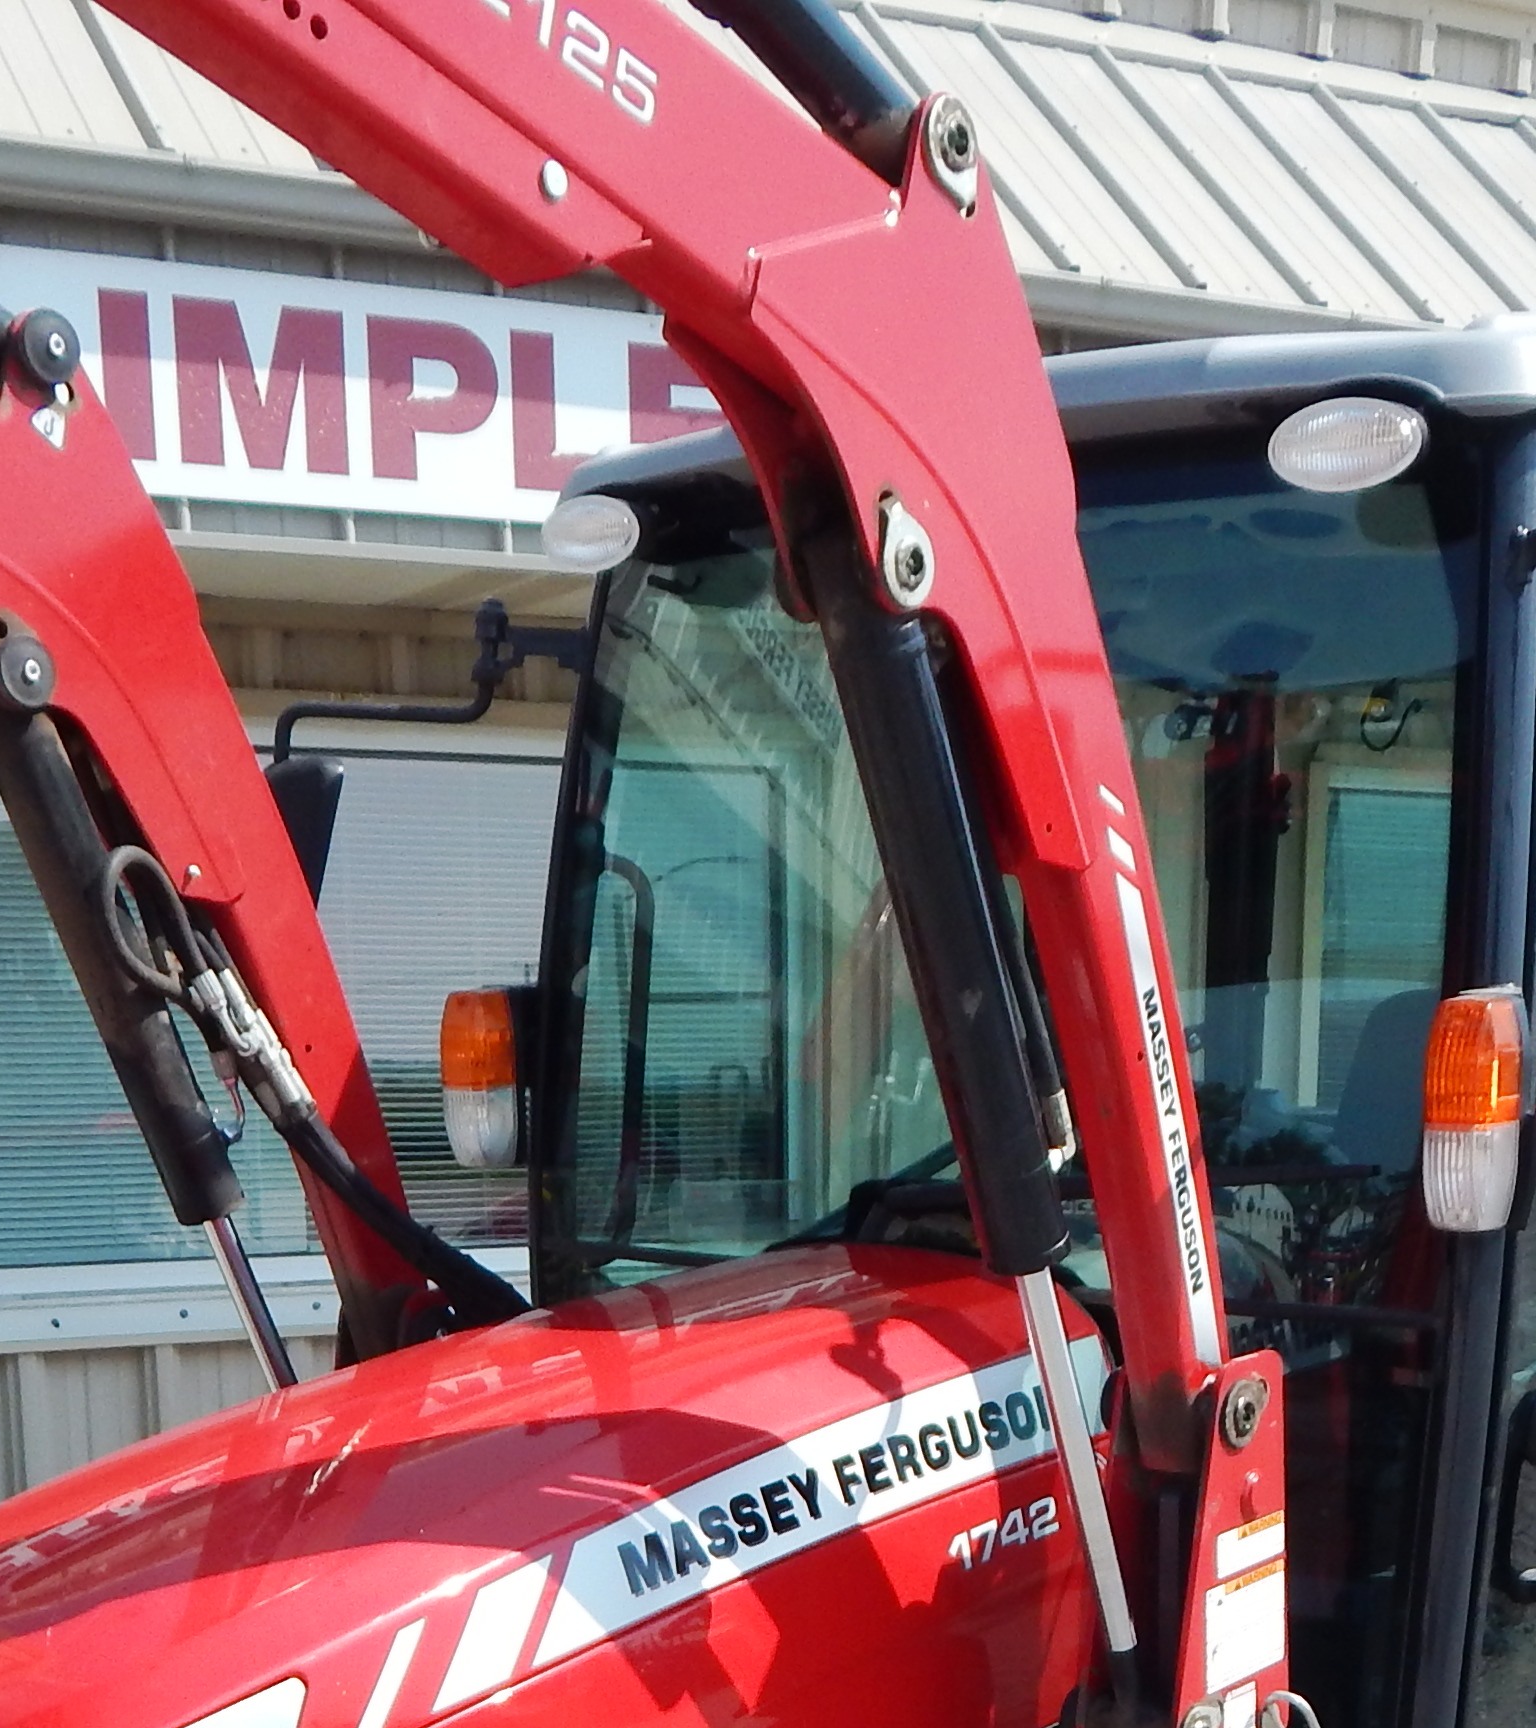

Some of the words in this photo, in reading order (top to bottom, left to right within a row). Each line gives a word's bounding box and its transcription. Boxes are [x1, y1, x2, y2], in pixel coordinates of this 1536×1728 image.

[480, 0, 659, 124] 125
[1142, 985, 1176, 1117] MASSEY
[1168, 1128, 1204, 1296] FERGUSON
[617, 1467, 822, 1597] MASSEY
[947, 1496, 1061, 1571] 1742
